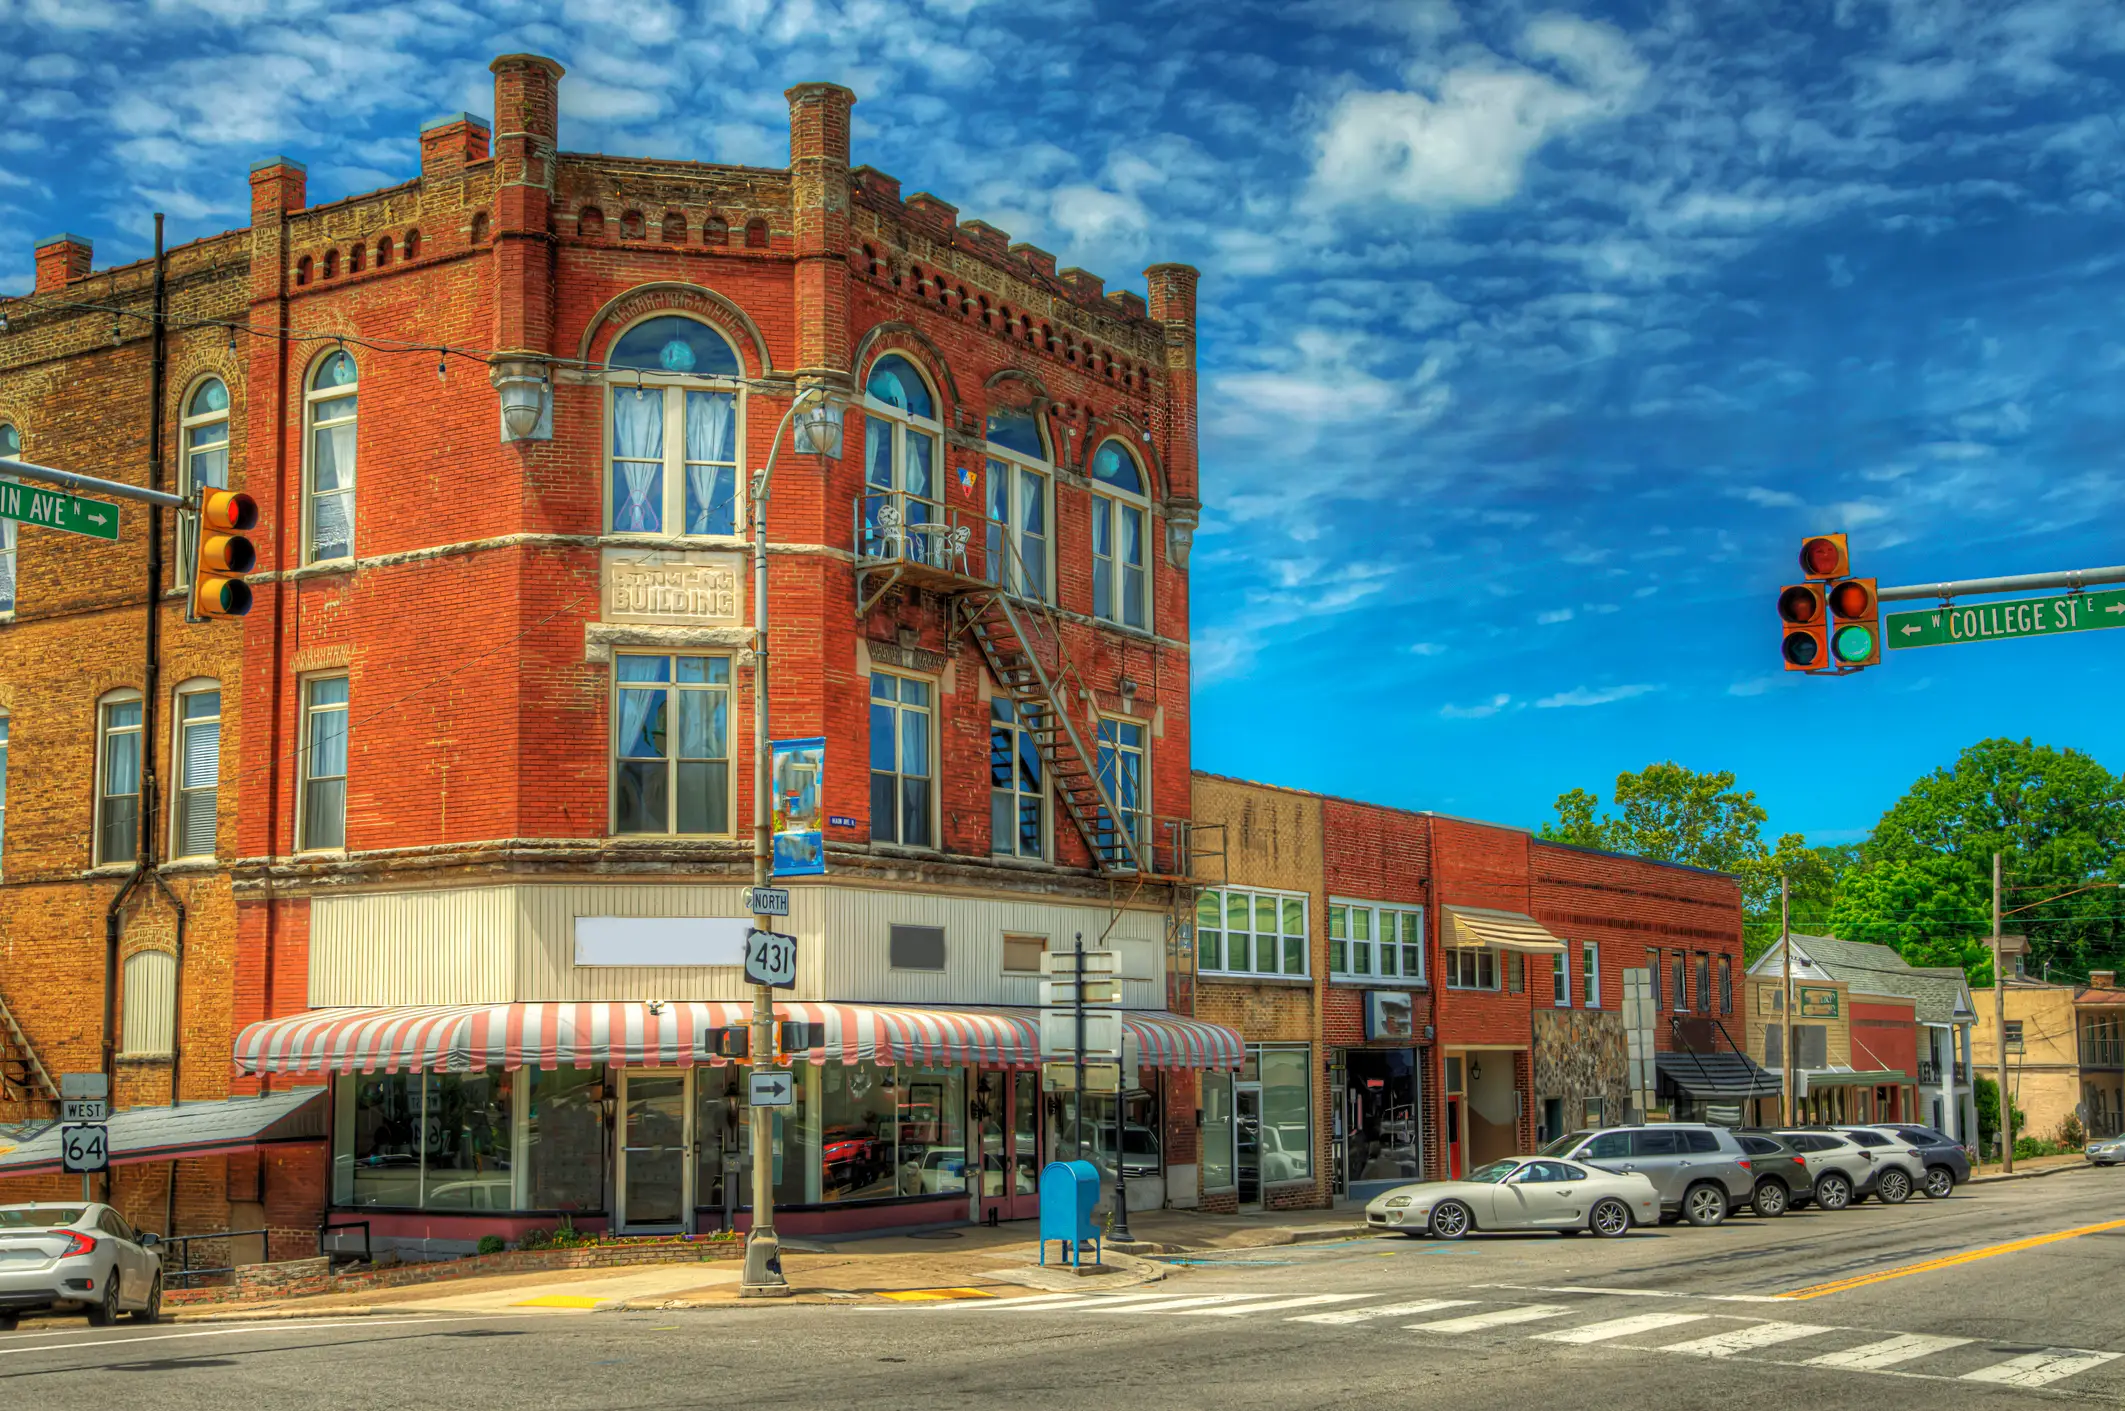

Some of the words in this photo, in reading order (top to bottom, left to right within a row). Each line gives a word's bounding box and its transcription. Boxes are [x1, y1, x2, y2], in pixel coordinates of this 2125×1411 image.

[29, 492, 66, 525] AVE
[73, 501, 81, 516] N
[612, 587, 734, 617] BUILDING
[1931, 614, 1941, 628] W
[1950, 603, 2046, 639] COLLEGE
[2054, 600, 2078, 629] ST
[2087, 598, 2094, 612] E
[755, 893, 787, 910] NORTH
[754, 942, 788, 974] 431
[68, 1104, 101, 1117] WEST
[68, 1135, 102, 1161] 64
